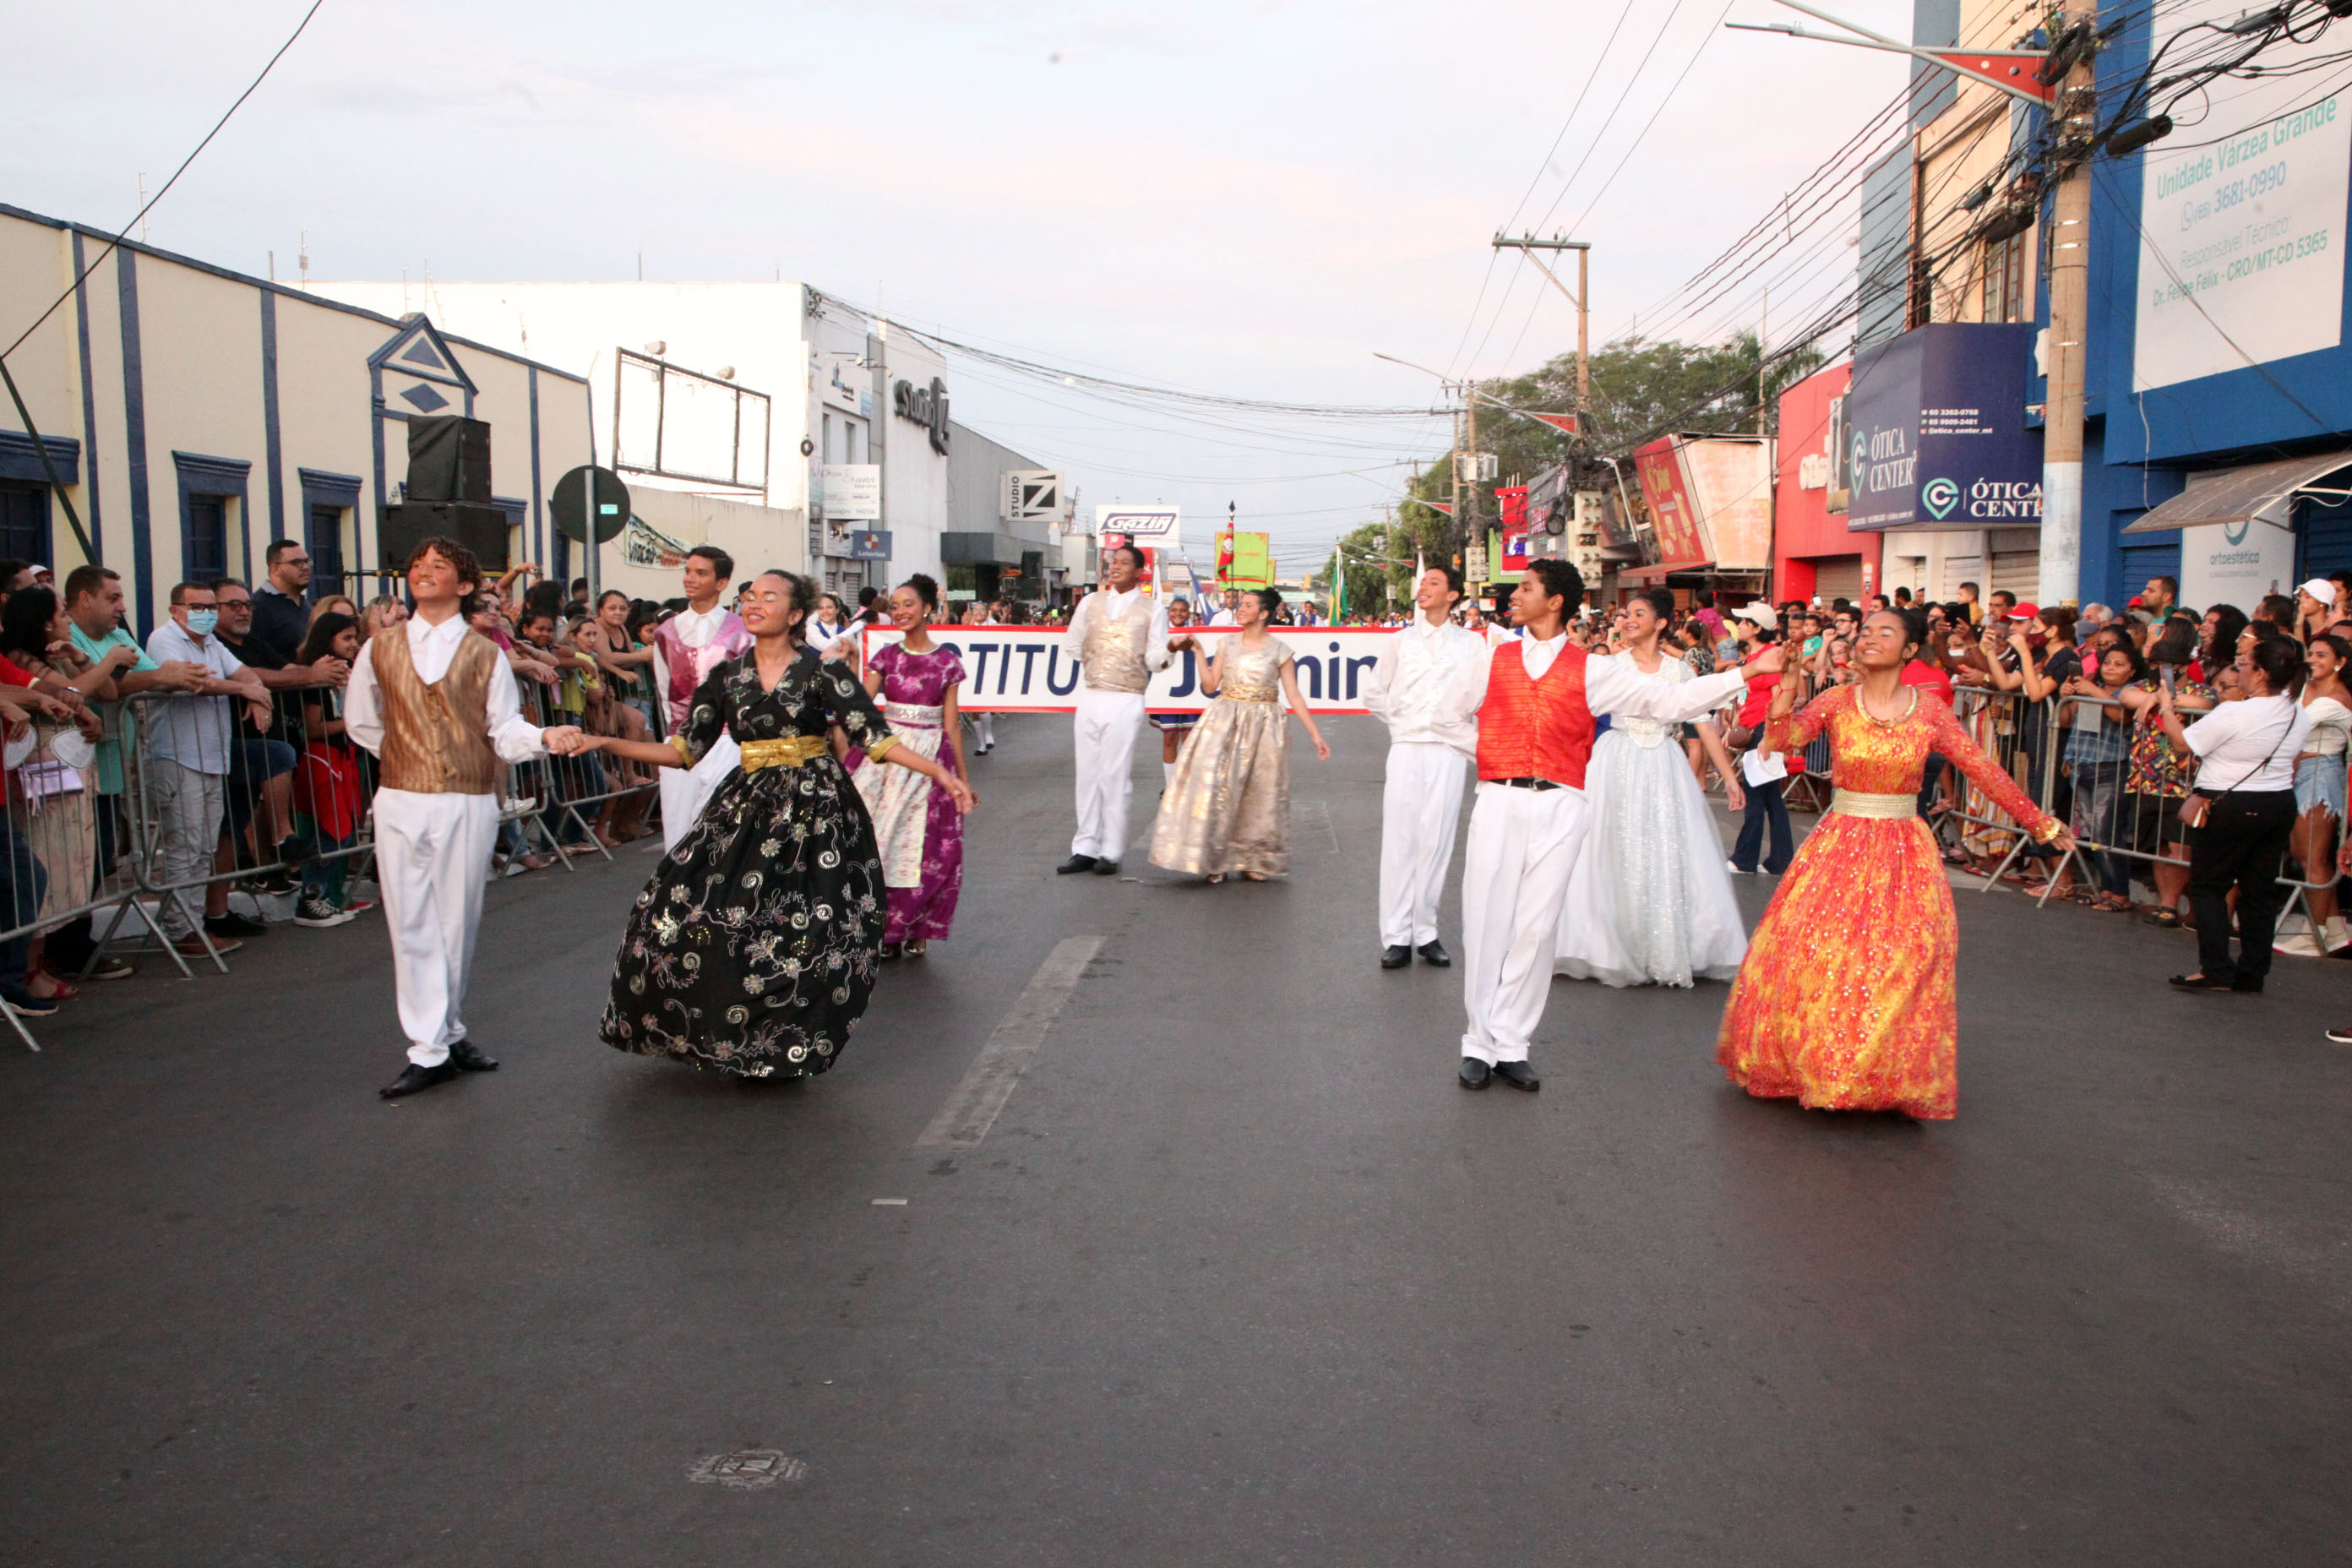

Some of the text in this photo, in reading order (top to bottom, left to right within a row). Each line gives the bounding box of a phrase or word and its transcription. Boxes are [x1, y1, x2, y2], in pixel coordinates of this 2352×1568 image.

[2157, 95, 2338, 200] Unidade Várzea Grande
[2215, 161, 2286, 213] 3681-0990
[2227, 242, 2294, 281] CRO/MT-CD
[2297, 229, 2328, 259] 5365
[1871, 426, 1906, 461] ÓTICA
[1011, 476, 1020, 518] STUDIO
[1870, 457, 1914, 493] CENTER
